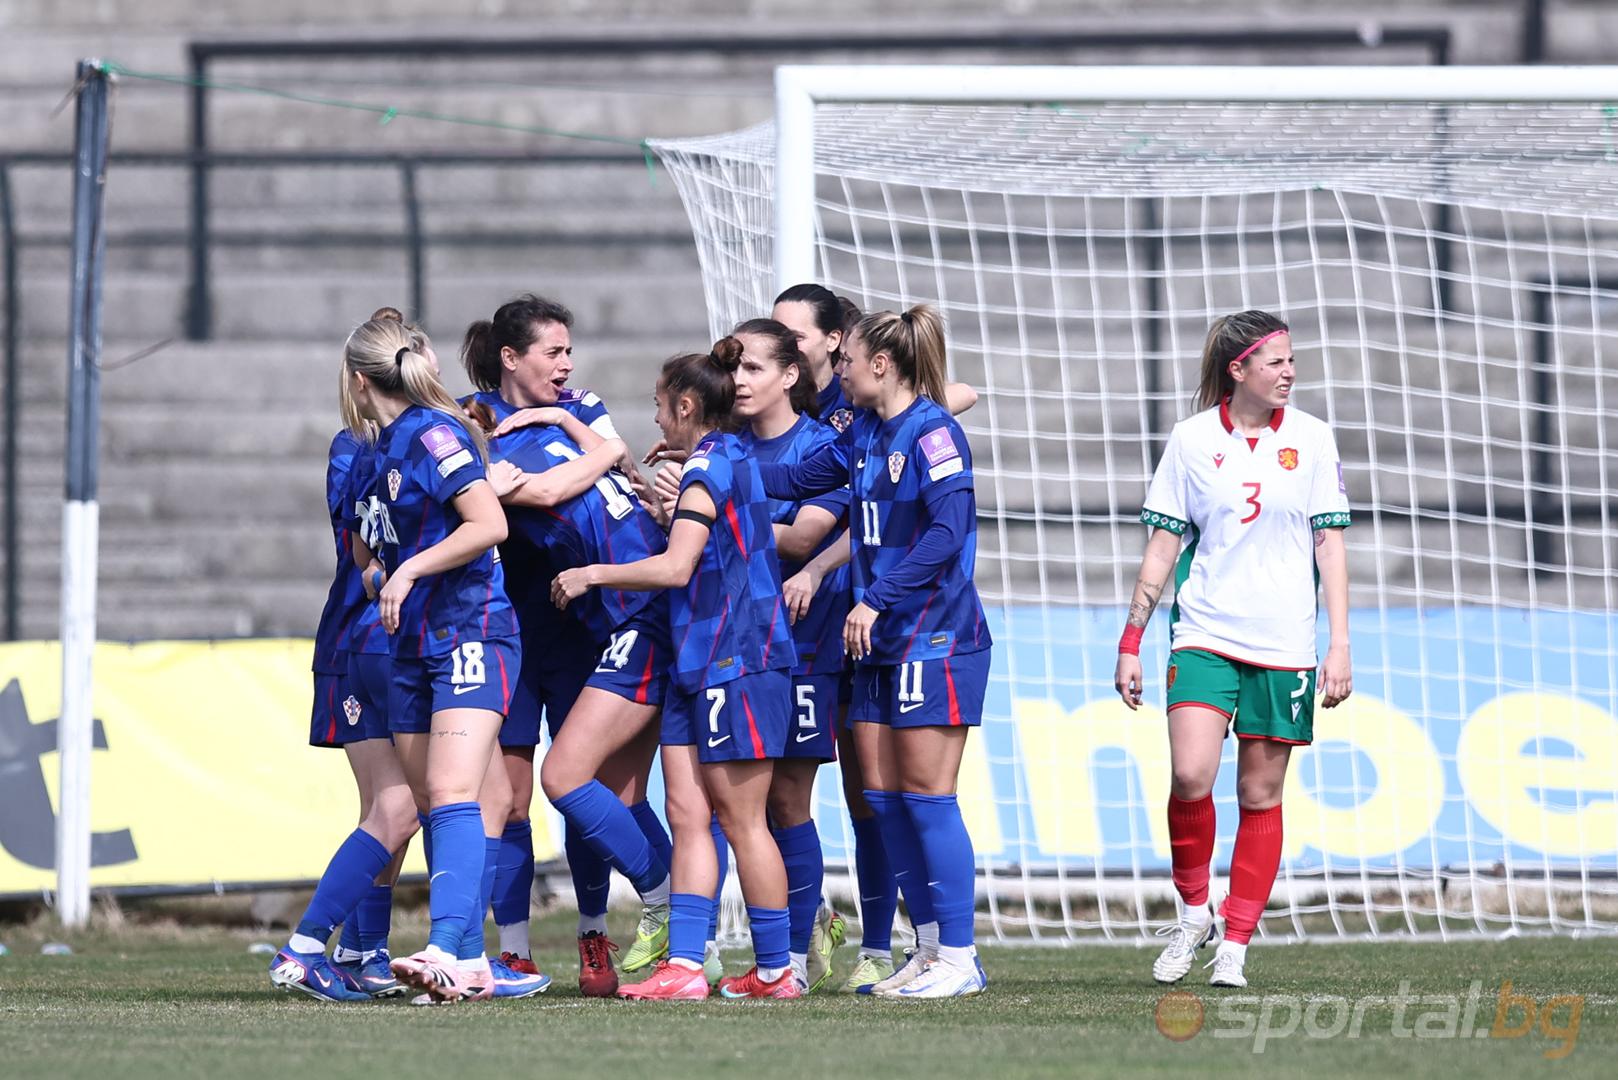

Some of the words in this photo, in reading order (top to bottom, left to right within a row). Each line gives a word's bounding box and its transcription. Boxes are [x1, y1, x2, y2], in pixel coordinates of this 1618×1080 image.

[862, 501, 882, 546] 11
[1240, 482, 1262, 525] 3
[450, 641, 486, 684] 18
[898, 660, 925, 702] 11
[706, 688, 726, 733] 7
[795, 684, 817, 729] 5
